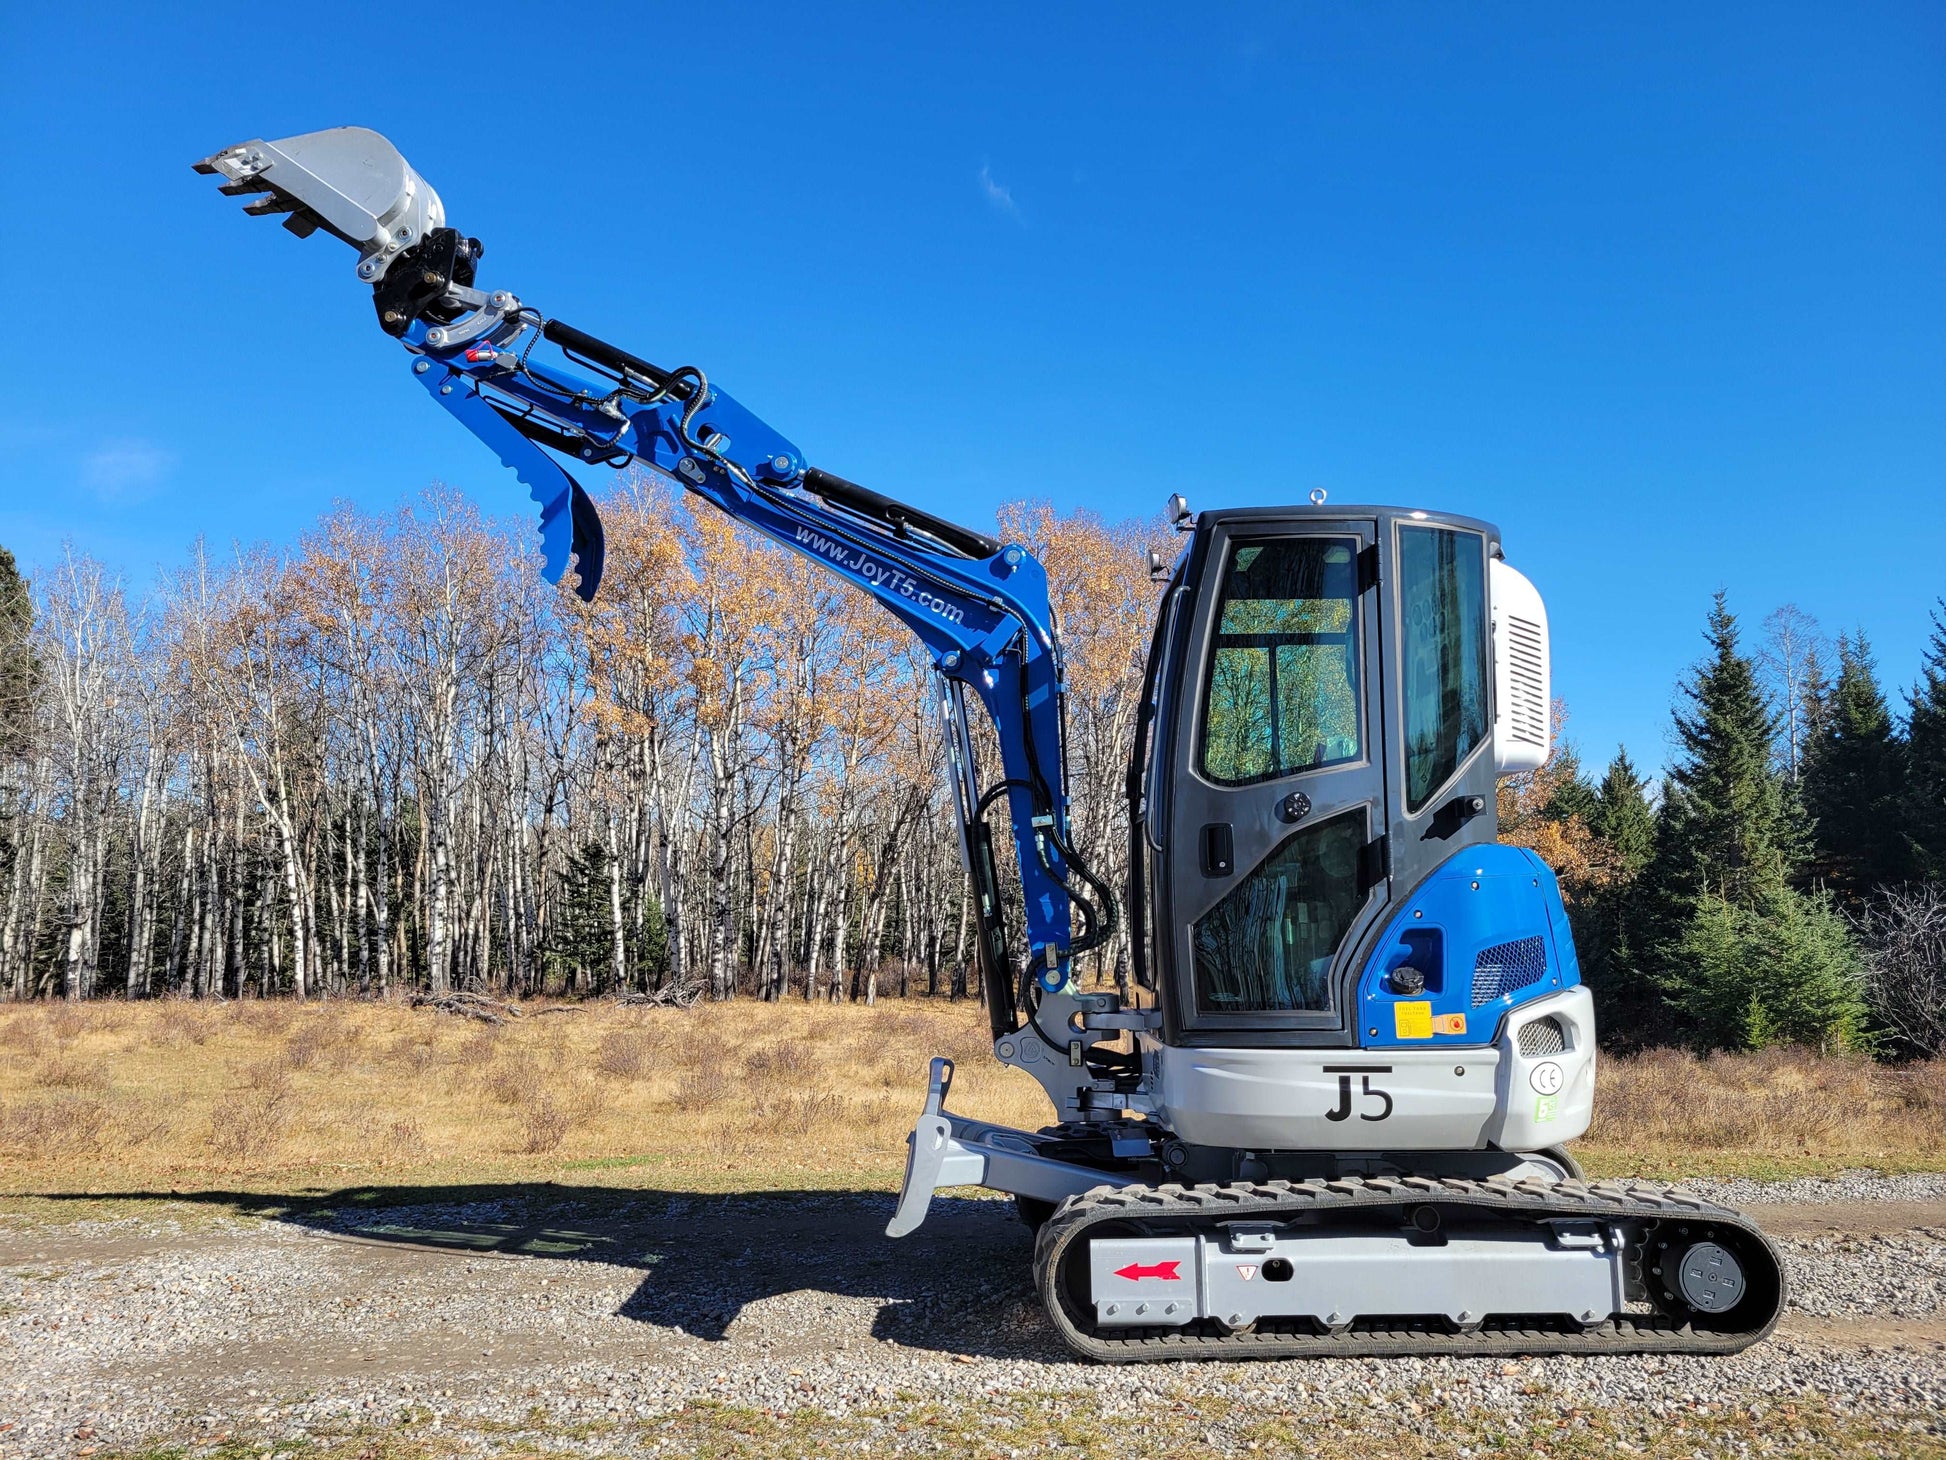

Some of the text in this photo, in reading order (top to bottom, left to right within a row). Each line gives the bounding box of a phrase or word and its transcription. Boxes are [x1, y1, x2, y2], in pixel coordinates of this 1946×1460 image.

[795, 526, 965, 625] www.JoyT5.com
[1322, 1065, 1394, 1122] J5
[1539, 1068, 1556, 1089] CE
